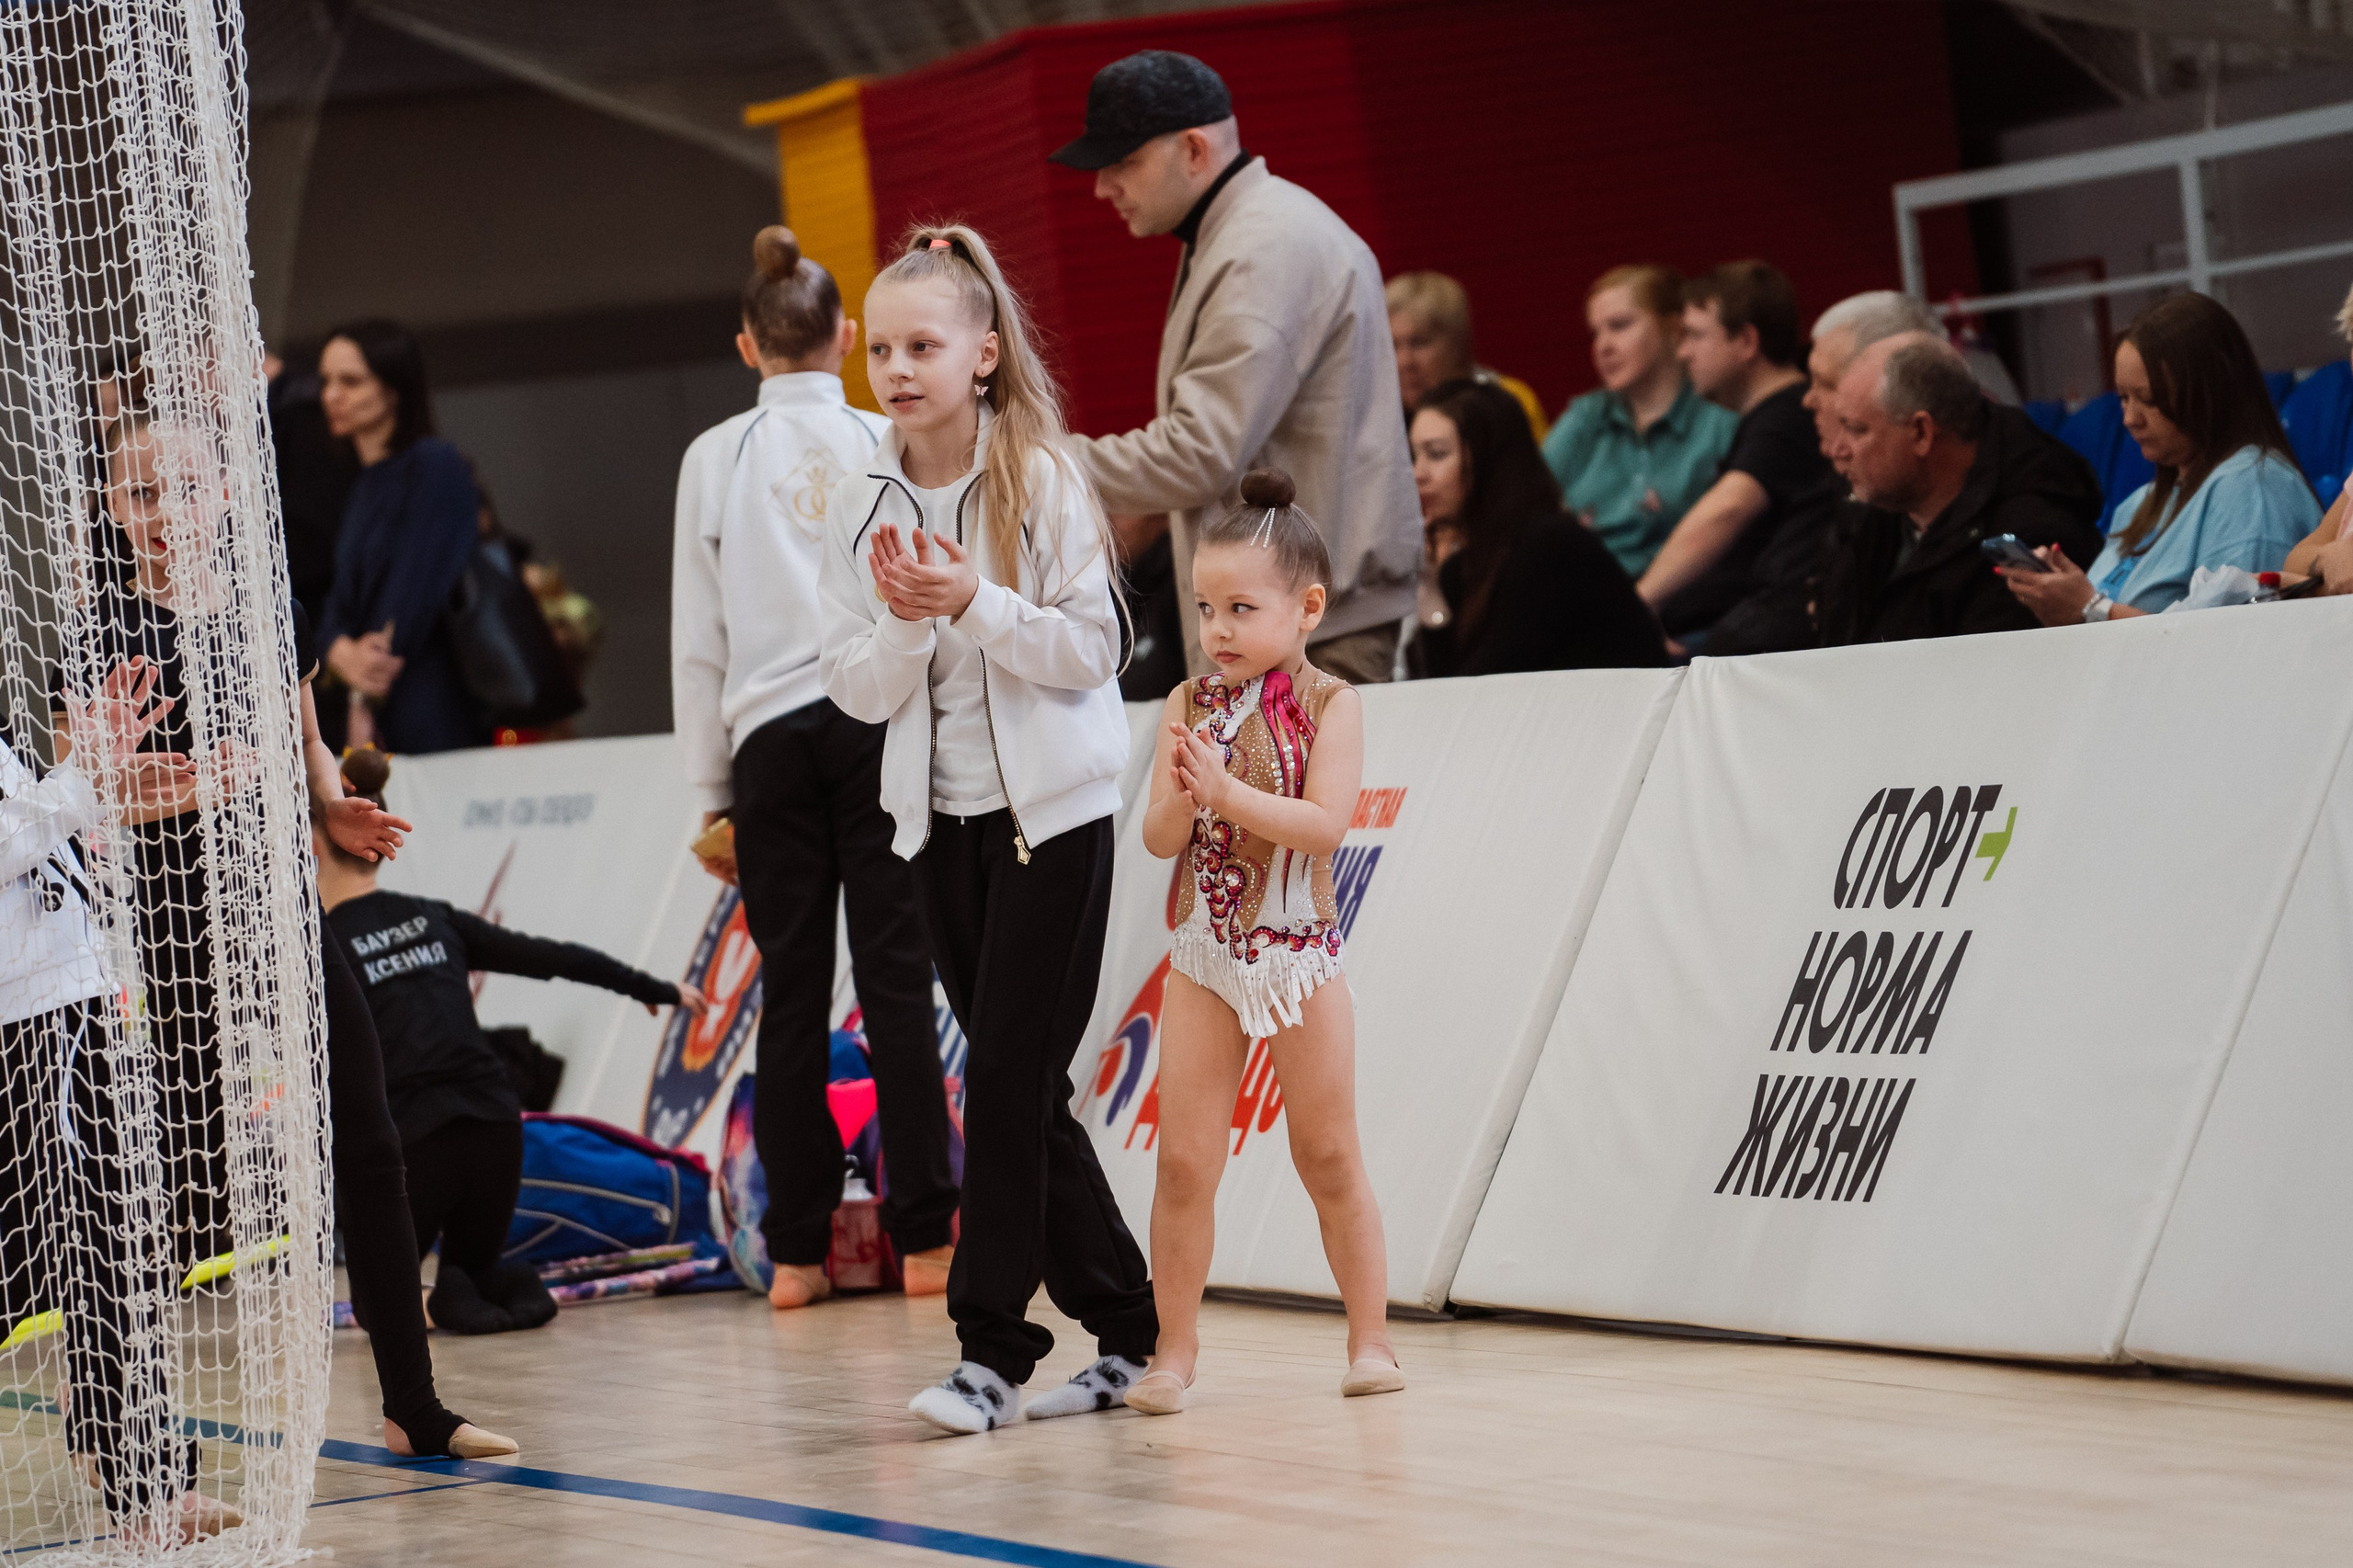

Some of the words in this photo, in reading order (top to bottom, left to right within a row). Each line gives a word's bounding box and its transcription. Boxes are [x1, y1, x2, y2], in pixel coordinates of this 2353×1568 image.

[1833, 784, 2003, 910] СПОРТ
[350, 915, 429, 957] БАУЗЕР
[363, 940, 449, 986] КСЕНИЯ
[1769, 930, 1973, 1055] НОРМА
[1713, 1074, 1917, 1203] ЖИЗНИ
